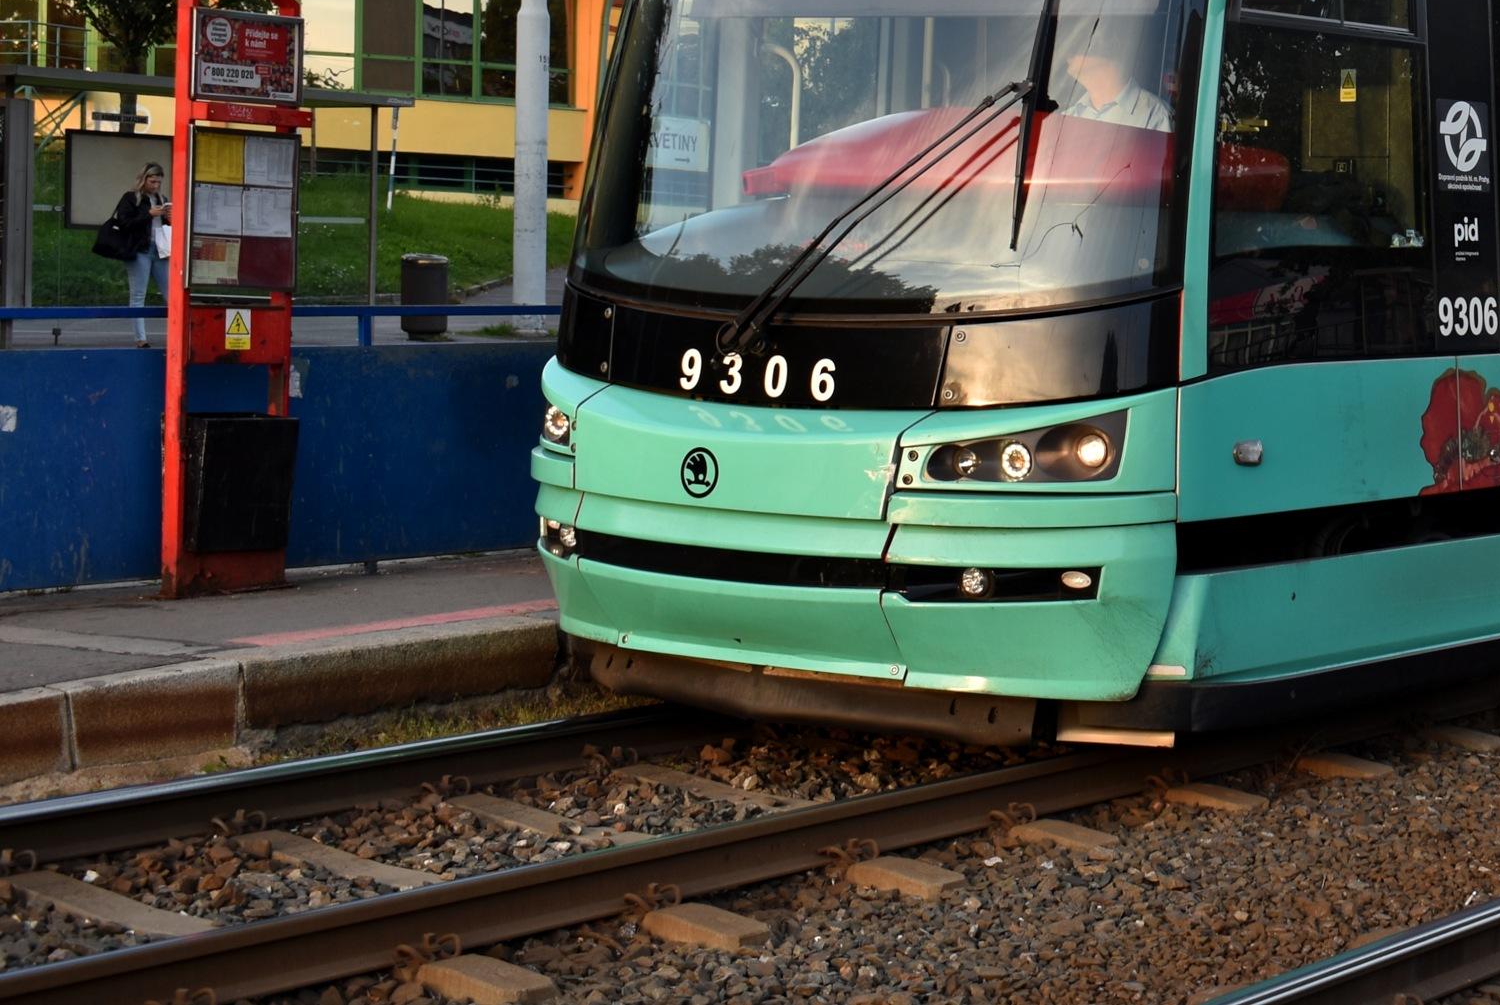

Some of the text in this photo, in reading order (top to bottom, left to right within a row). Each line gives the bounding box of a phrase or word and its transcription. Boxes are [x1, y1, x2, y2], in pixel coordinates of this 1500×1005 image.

[211, 67, 225, 77] 800
[226, 68, 240, 78] 220
[240, 69, 255, 80] 020
[1453, 216, 1480, 247] pid
[1438, 296, 1499, 337] 9306
[679, 347, 837, 402] 9306
